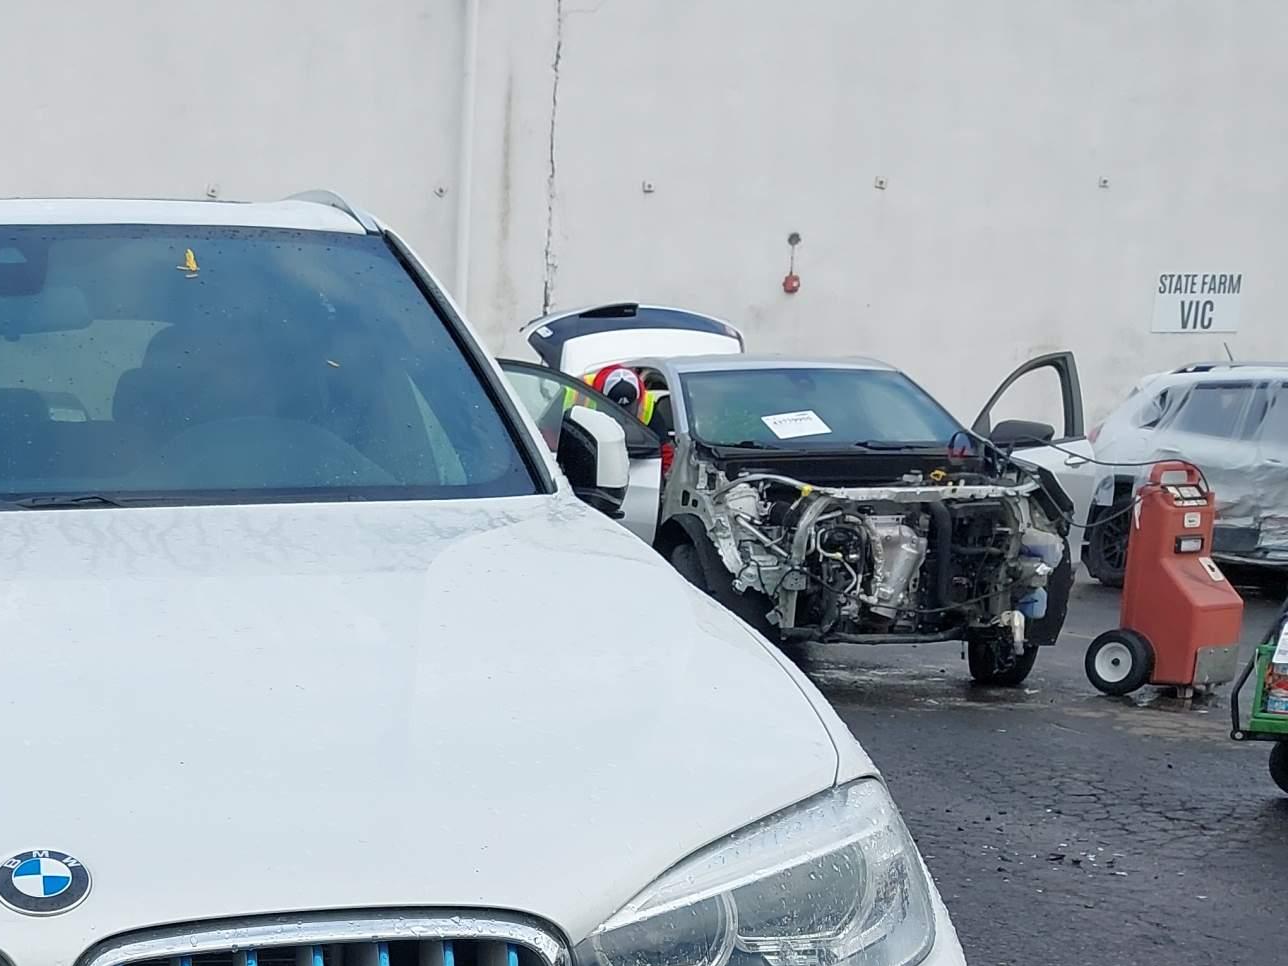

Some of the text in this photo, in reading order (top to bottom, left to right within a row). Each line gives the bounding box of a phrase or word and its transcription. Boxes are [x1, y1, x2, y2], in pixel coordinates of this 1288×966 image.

[1158, 273, 1242, 294] STATE FARM
[1180, 299, 1214, 330] VIC
[3, 849, 81, 869] BMW
